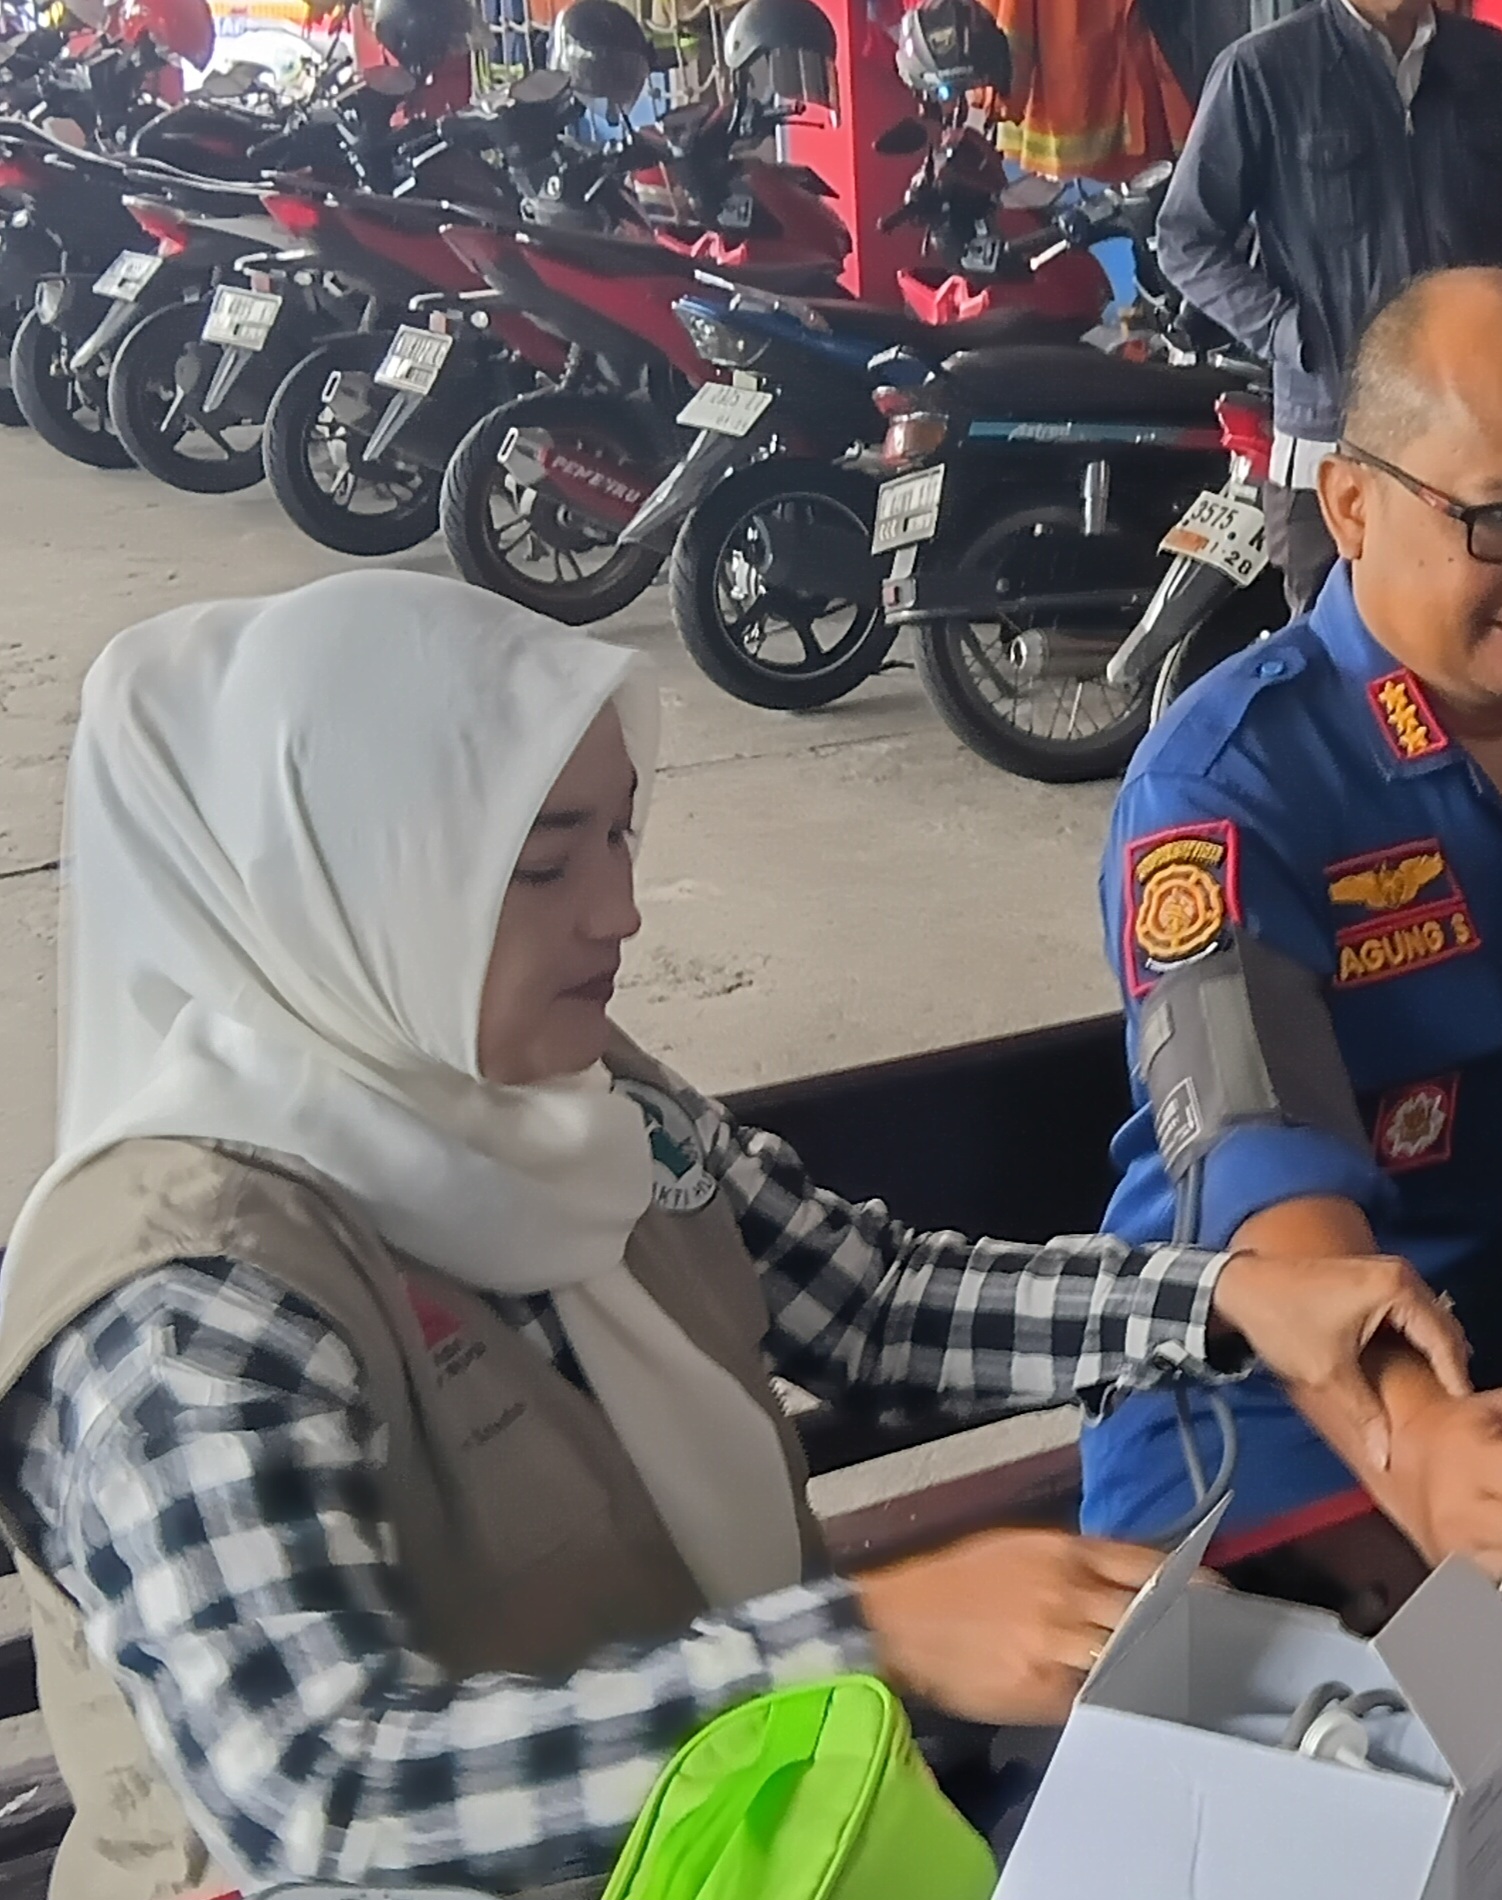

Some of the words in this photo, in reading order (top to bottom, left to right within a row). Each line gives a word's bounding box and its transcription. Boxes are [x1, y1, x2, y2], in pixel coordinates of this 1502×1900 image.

[1191, 500, 1239, 530] 3575
[1340, 920, 1445, 981] AGUNG
[1451, 912, 1471, 945] S
